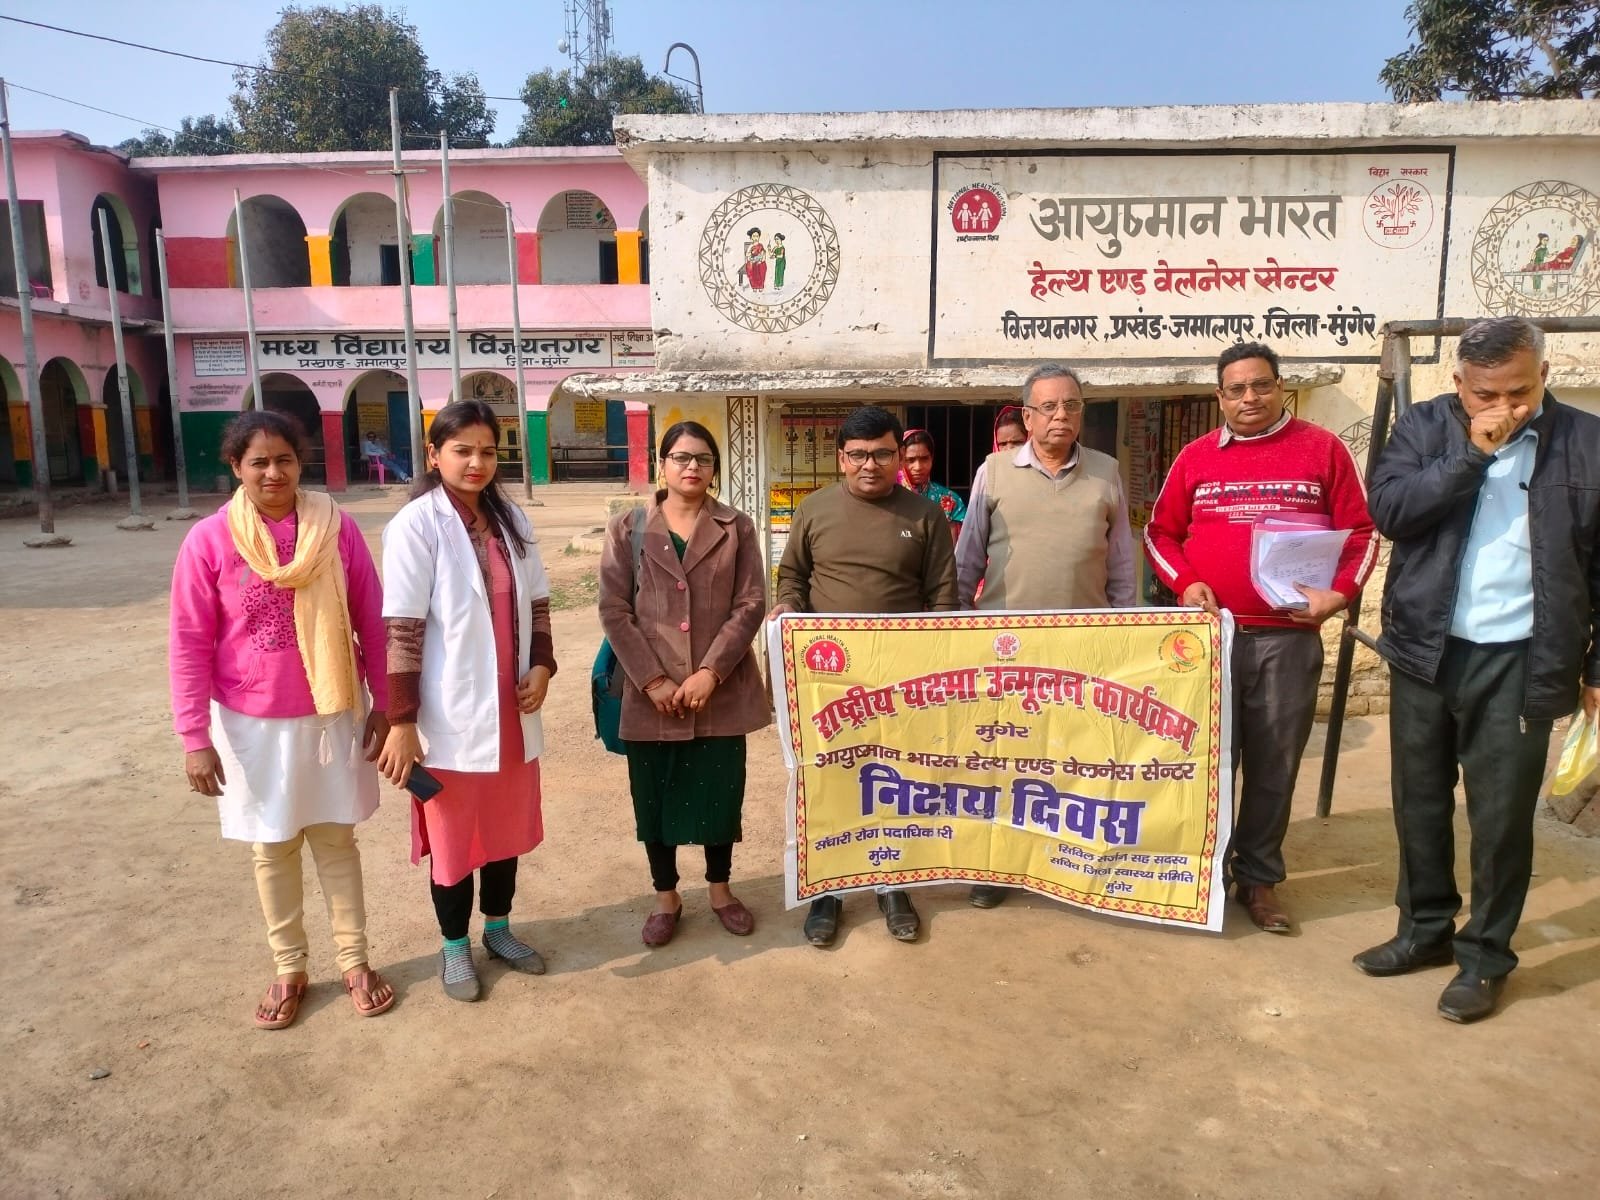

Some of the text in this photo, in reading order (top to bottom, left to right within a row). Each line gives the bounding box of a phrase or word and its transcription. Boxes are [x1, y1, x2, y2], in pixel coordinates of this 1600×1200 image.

[1368, 166, 1429, 177] बिहार सरकार
[1029, 195, 1343, 259] आयुष्मान भारत
[1027, 257, 1339, 302] हेल्थ एण्ड वेलनेस सेन्टर
[260, 331, 605, 357] मध्य विद्यालय विजयनगर
[354, 358, 407, 369] जमालपुर
[1257, 484, 1321, 498] WEAR
[811, 685, 896, 742] राष्ट्रीय
[984, 666, 1088, 713] उन्मूलन
[1091, 676, 1200, 754] कार्यक्रम
[975, 720, 1031, 743] मुंगेर
[814, 744, 1197, 781] आयुष्मान भारत हेल्थ एण्ड वेलनेस सेन्टर
[859, 762, 1146, 846] निक्षय दिवस
[855, 827, 879, 842] रोग
[868, 846, 901, 866] मुंगेर
[1058, 843, 1095, 861] सिविल
[1131, 853, 1151, 864] सह
[1153, 854, 1188, 865] सदस्य
[1050, 856, 1195, 883] सचिव जिला स्वास्थ्य समिति
[1105, 881, 1133, 894] मुंगेर
